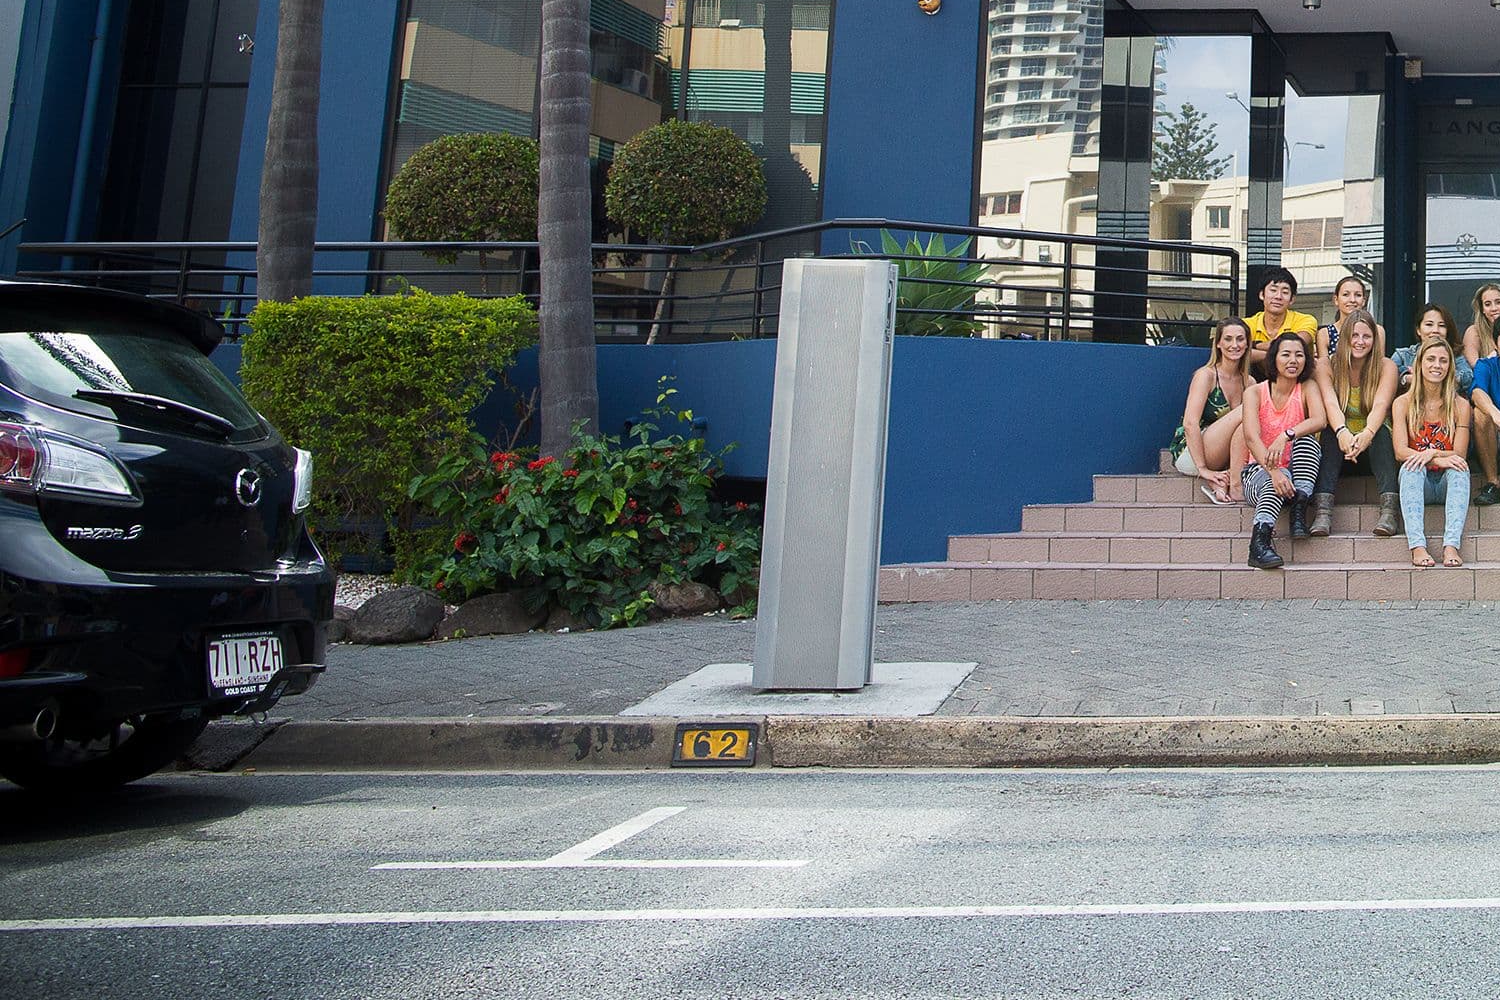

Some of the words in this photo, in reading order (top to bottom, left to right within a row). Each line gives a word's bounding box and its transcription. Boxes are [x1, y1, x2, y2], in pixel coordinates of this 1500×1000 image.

[225, 686, 240, 696] GOLD
[240, 685, 257, 694] COAST
[693, 731, 738, 758] 62
